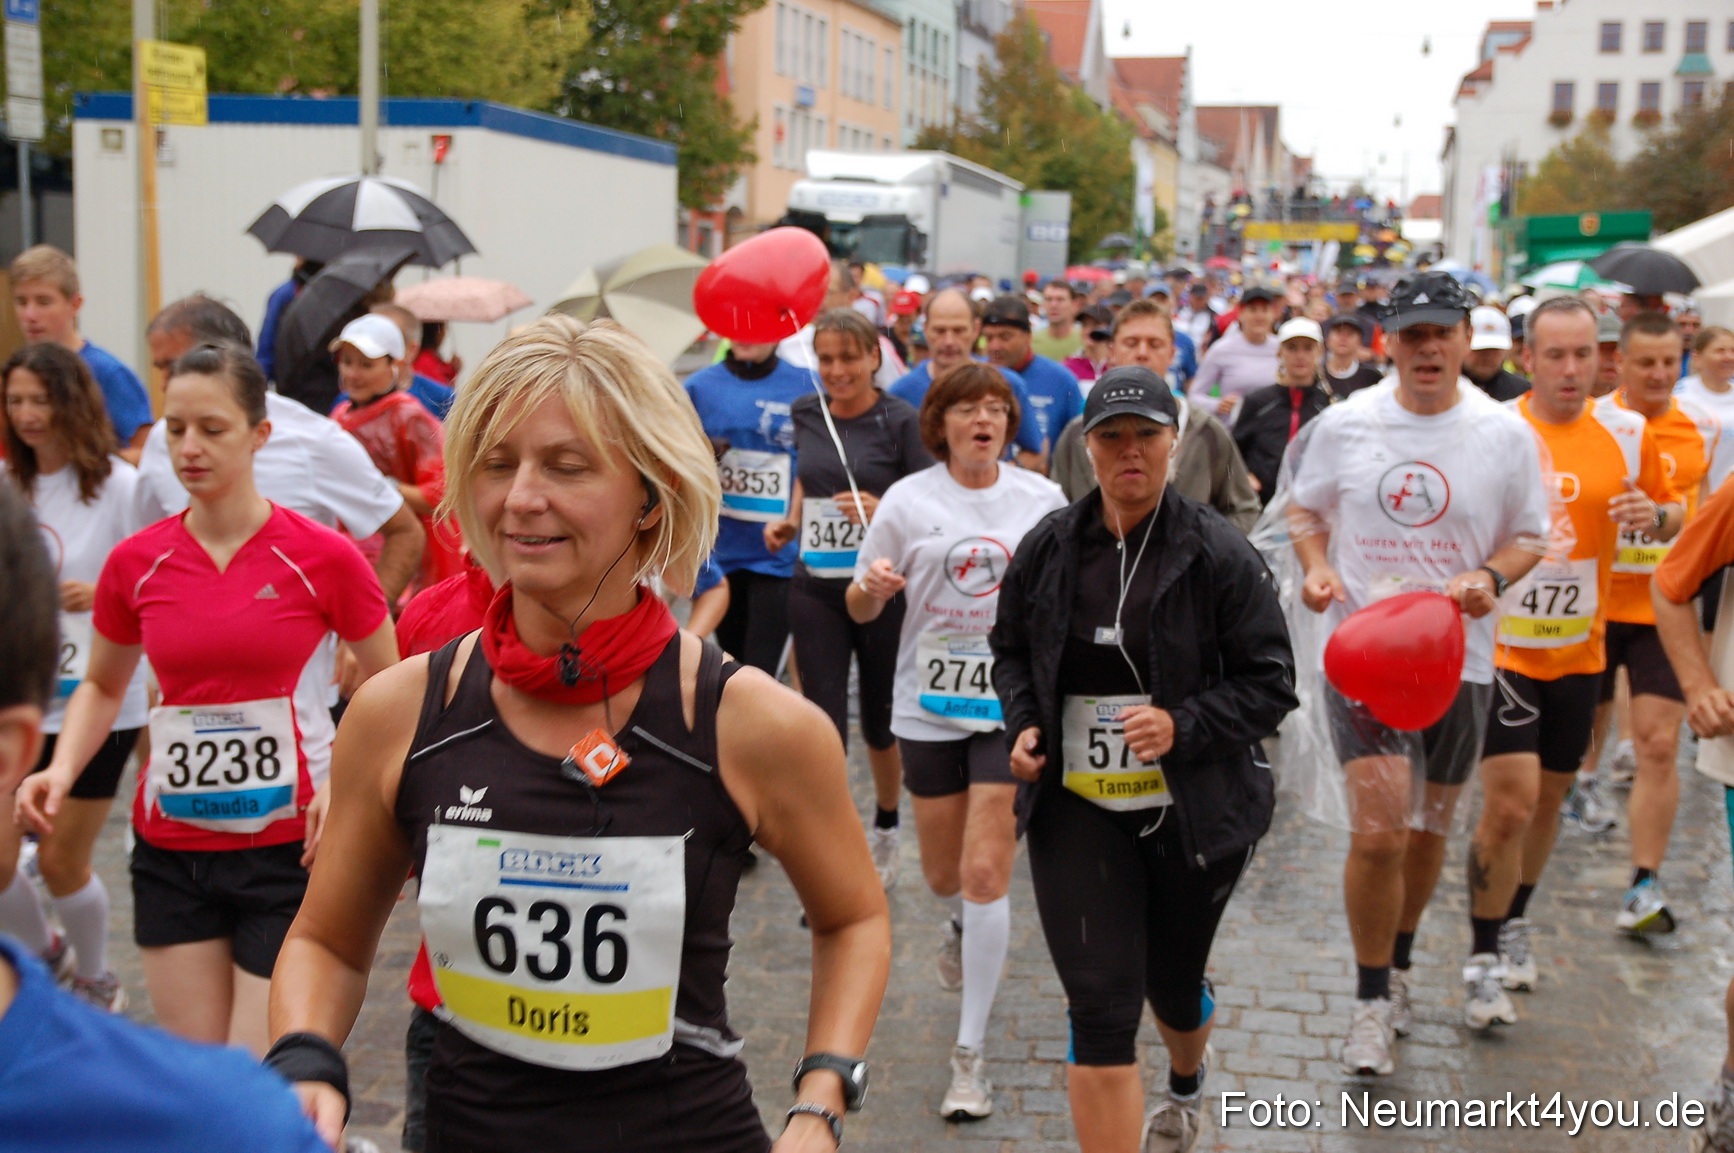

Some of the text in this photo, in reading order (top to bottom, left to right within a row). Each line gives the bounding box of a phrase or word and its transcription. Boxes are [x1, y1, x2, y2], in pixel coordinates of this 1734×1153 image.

[721, 466, 781, 496] 3353
[1521, 584, 1580, 616] 472
[943, 700, 990, 717] Andrea
[167, 735, 281, 788] 3238
[1095, 778, 1160, 796] Tamara
[191, 797, 260, 816] Claudia
[445, 804, 493, 823] erima
[499, 848, 602, 877] BOCK
[473, 895, 629, 985] 636
[506, 994, 591, 1038] Doris
